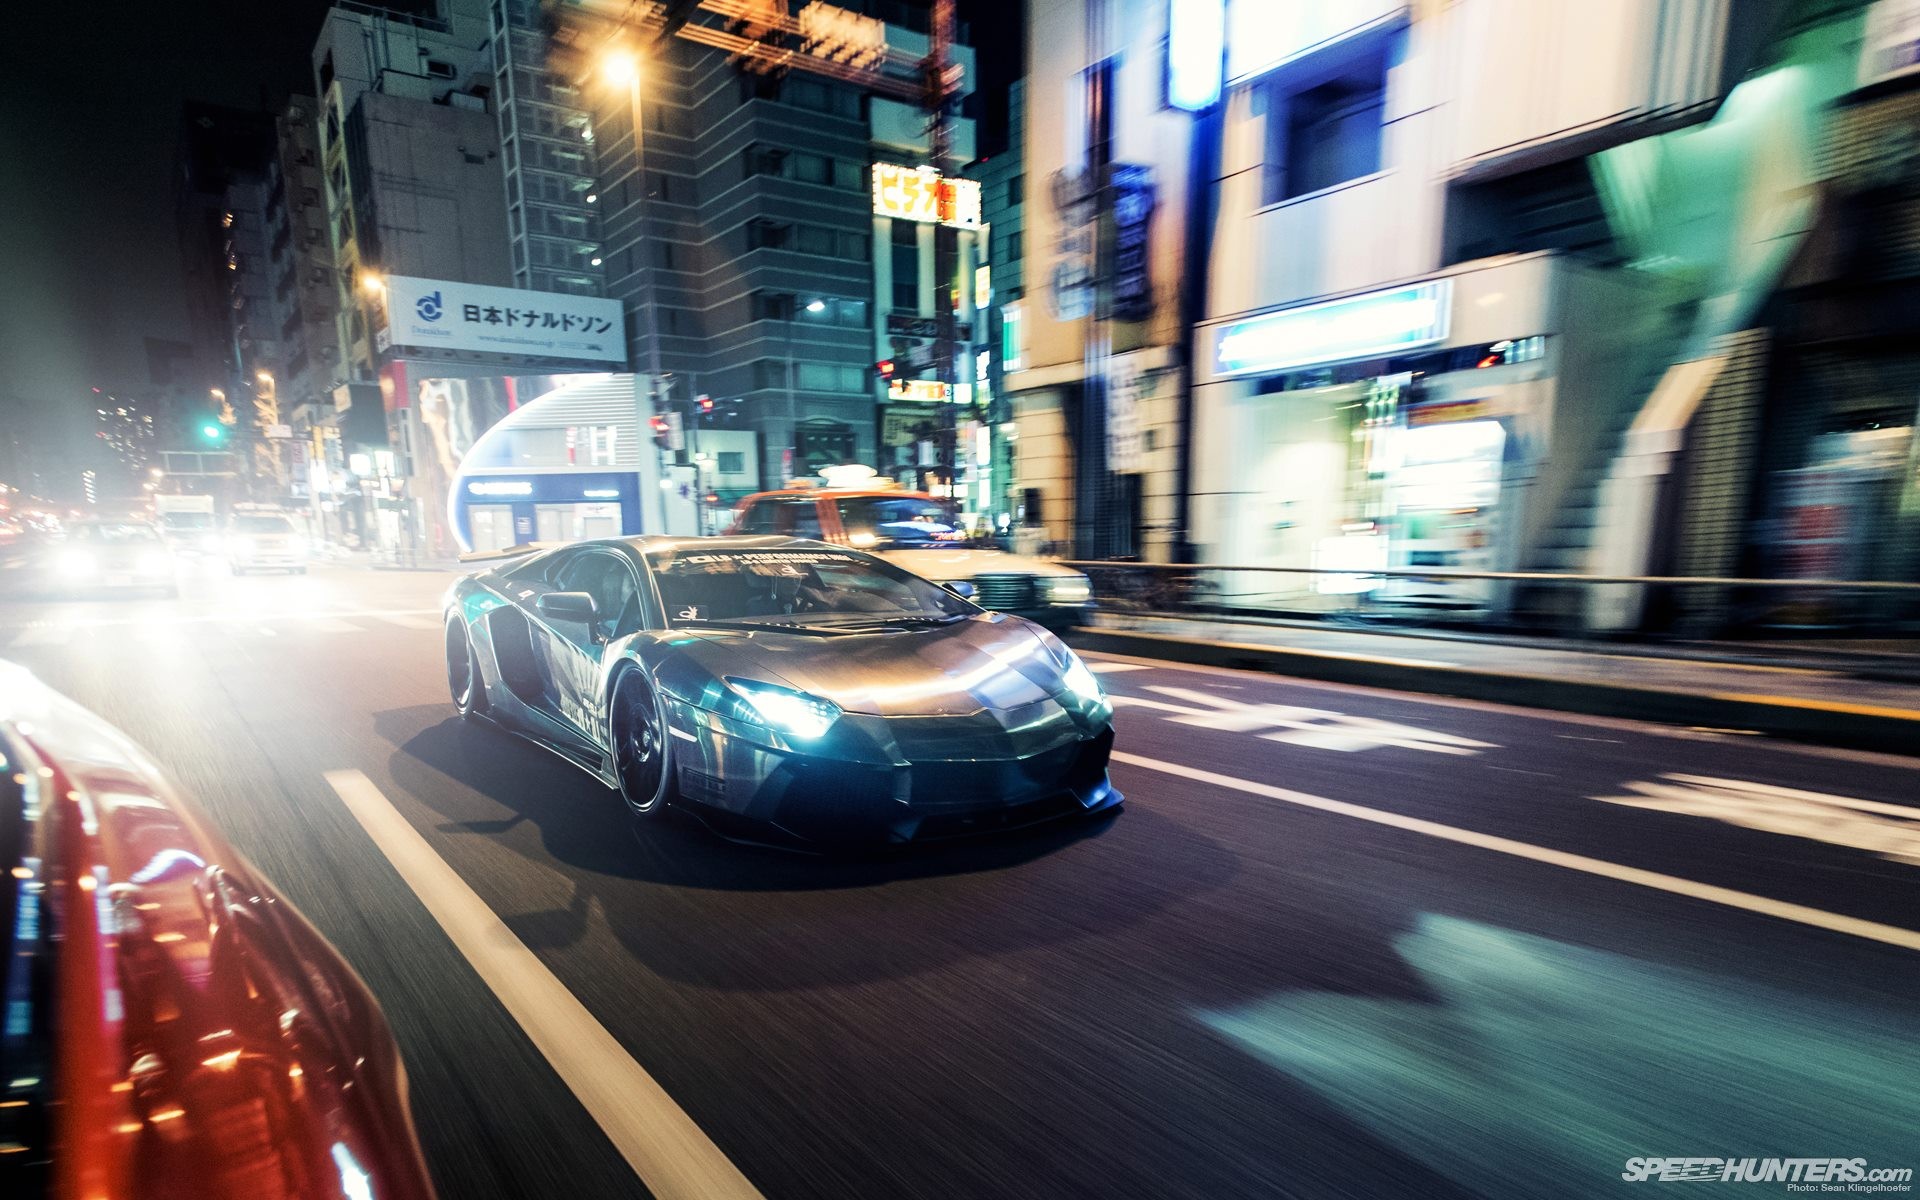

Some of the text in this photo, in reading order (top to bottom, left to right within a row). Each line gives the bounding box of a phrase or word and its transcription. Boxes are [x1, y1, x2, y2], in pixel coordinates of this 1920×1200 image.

[463, 304, 612, 334] 日本ドナルドソン
